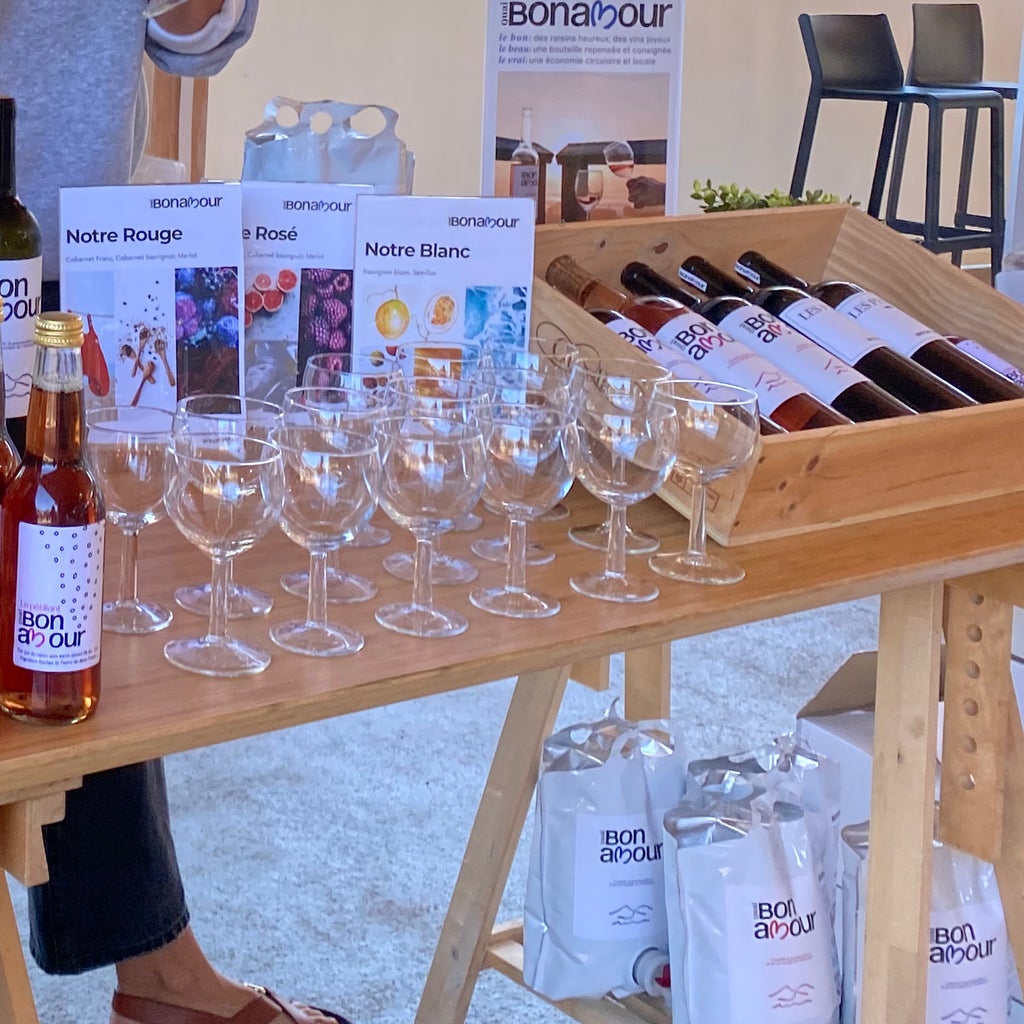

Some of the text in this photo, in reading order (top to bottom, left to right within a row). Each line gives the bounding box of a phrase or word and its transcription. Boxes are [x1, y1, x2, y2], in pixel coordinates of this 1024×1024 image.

[66, 227, 183, 245] Notre Rouge
[256, 226, 298, 241] Rosé
[365, 242, 470, 259] Notre Blanc
[23, 610, 64, 630] Bon
[605, 828, 645, 845] Bon
[600, 842, 663, 864] amour
[759, 897, 796, 920] Bon
[754, 911, 816, 940] amour
[935, 922, 976, 945] Bon
[929, 937, 997, 965] amour
